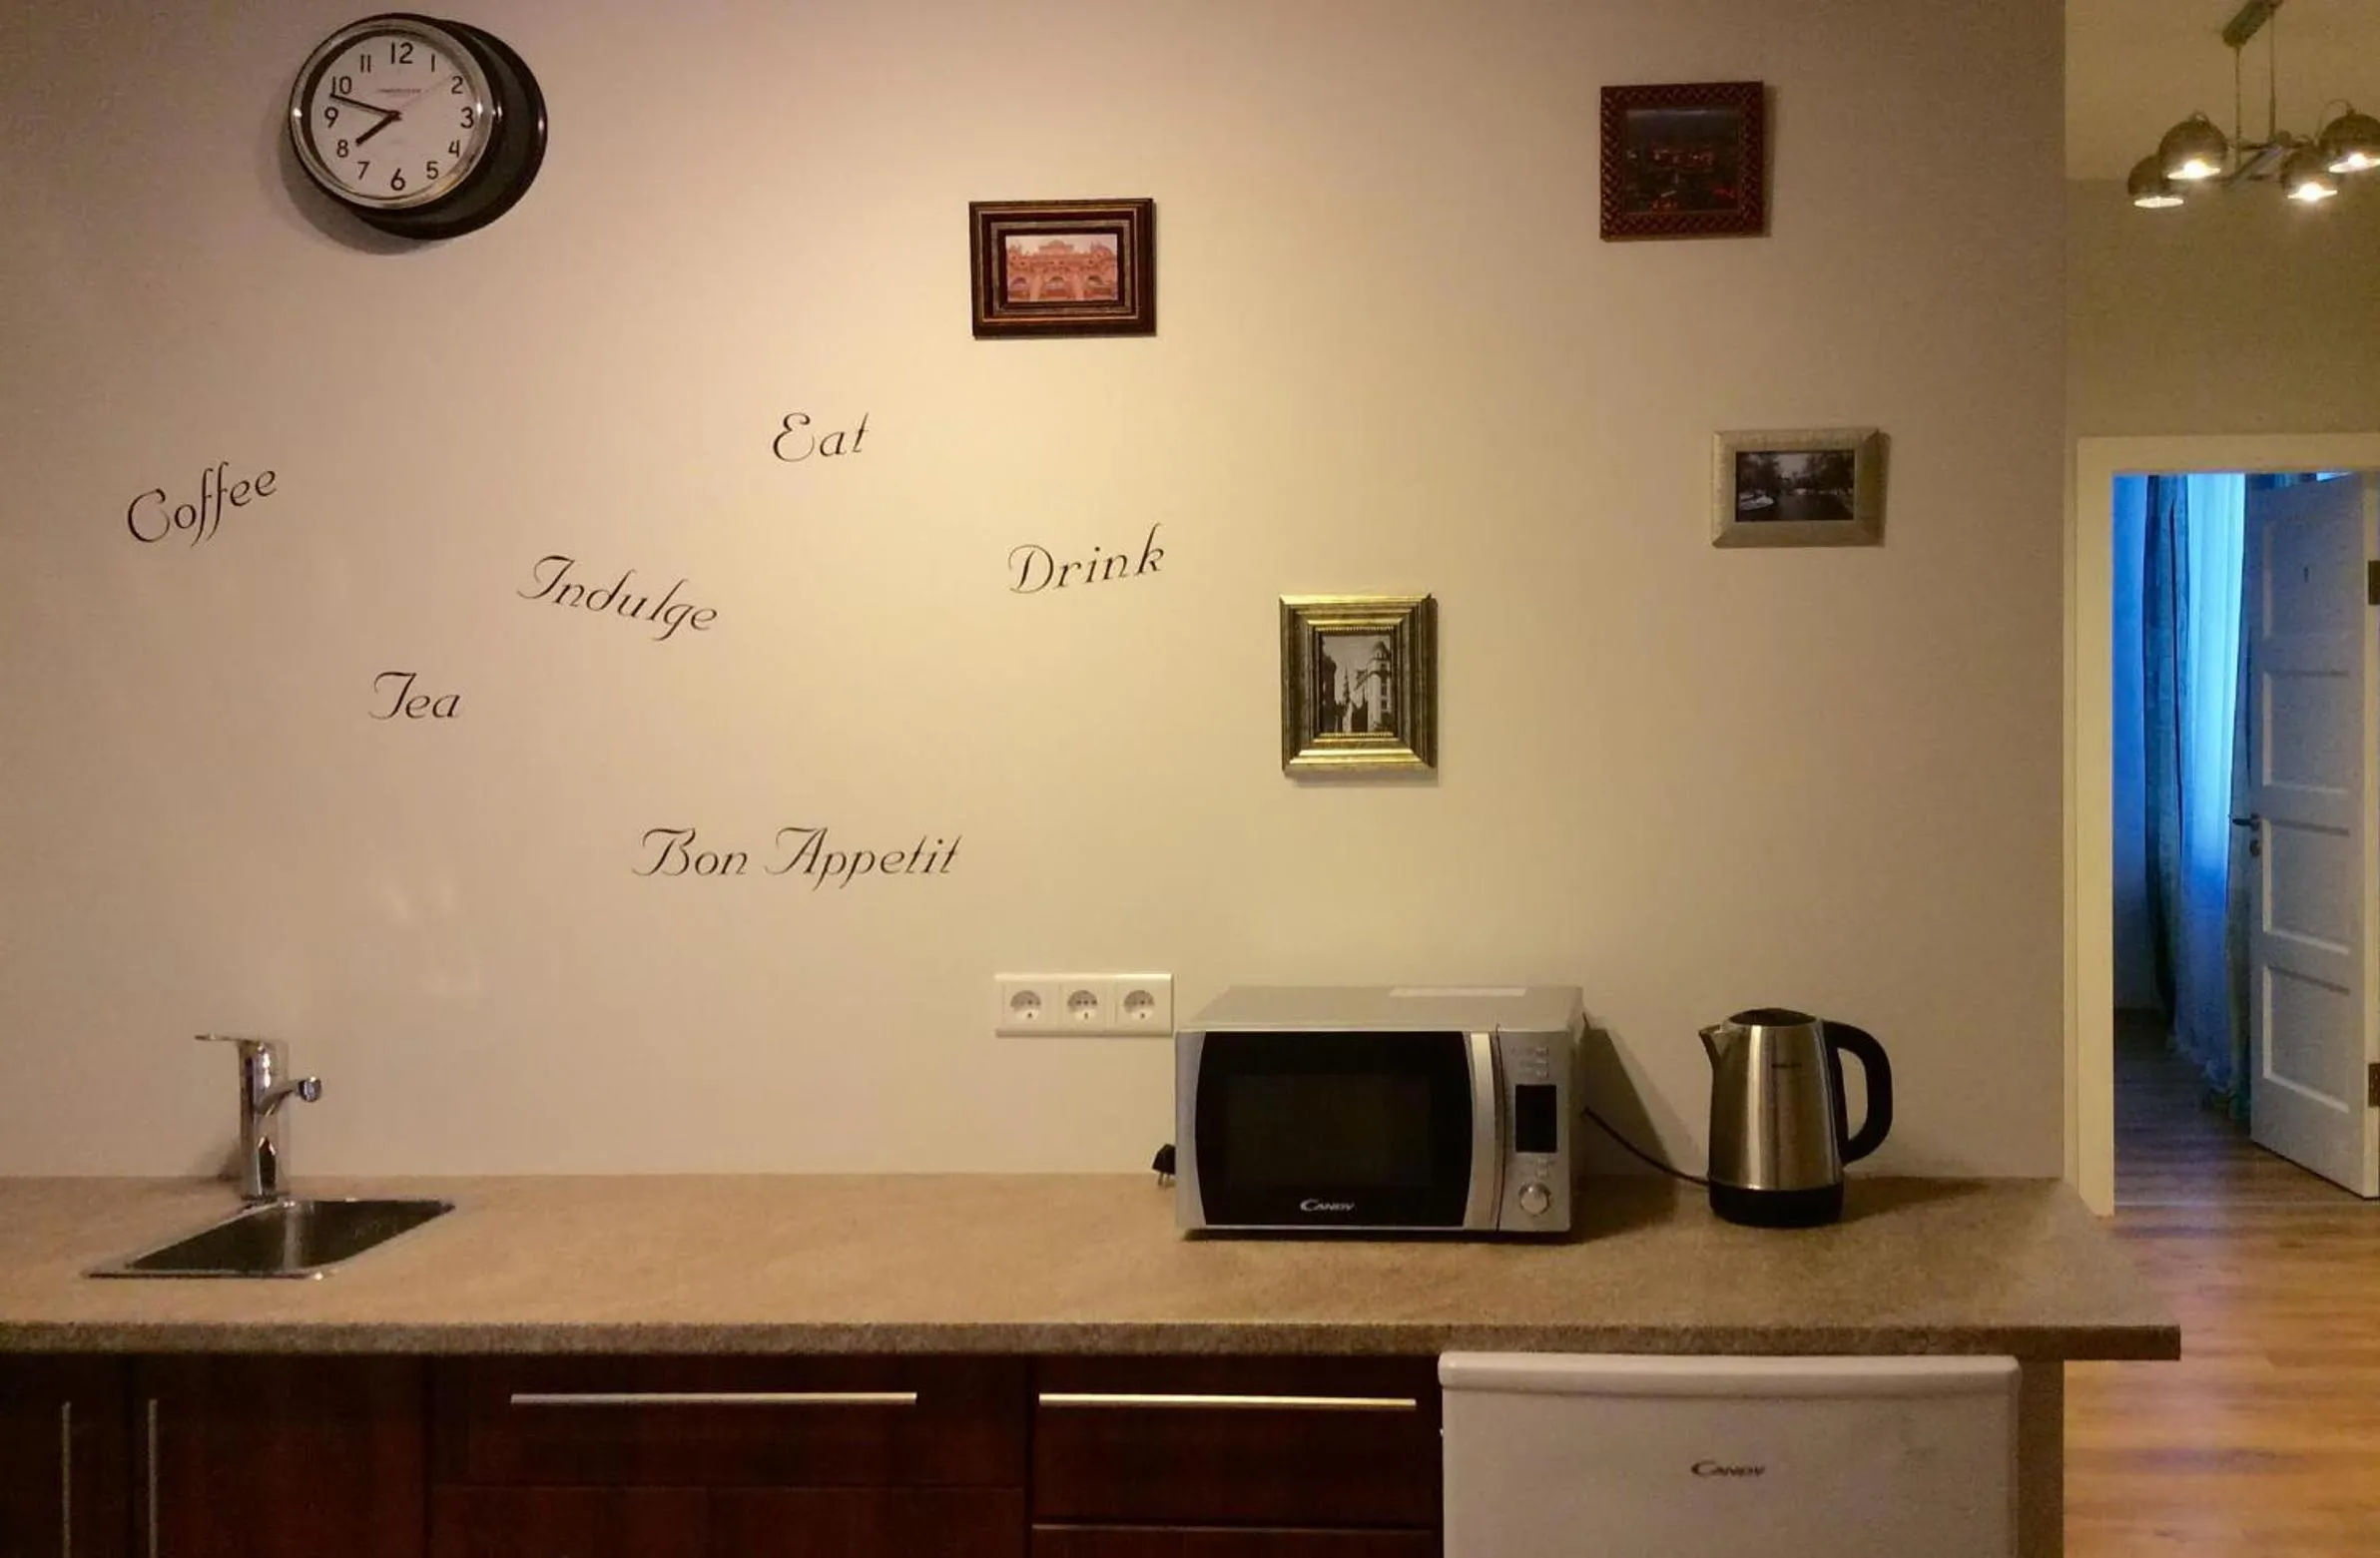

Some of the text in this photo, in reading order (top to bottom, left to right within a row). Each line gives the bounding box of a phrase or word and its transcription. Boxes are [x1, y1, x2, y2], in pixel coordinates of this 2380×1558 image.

[359, 54, 371, 73] 11
[390, 41, 413, 64] 12
[430, 53, 436, 72] 1
[330, 76, 352, 95] 10
[451, 76, 463, 95] 2
[323, 106, 338, 129] 9
[460, 106, 474, 129] 3
[336, 139, 349, 159] 8
[448, 139, 460, 158] 4
[356, 161, 370, 180] 7
[390, 168, 405, 192] 6
[425, 161, 439, 180] 5
[772, 411, 870, 463] Eat
[127, 460, 278, 547] Coffee
[1008, 522, 1165, 594] Drink
[516, 554, 719, 642] Indulge
[368, 671, 462, 721] Tea
[632, 826, 962, 891] Bon Appetit
